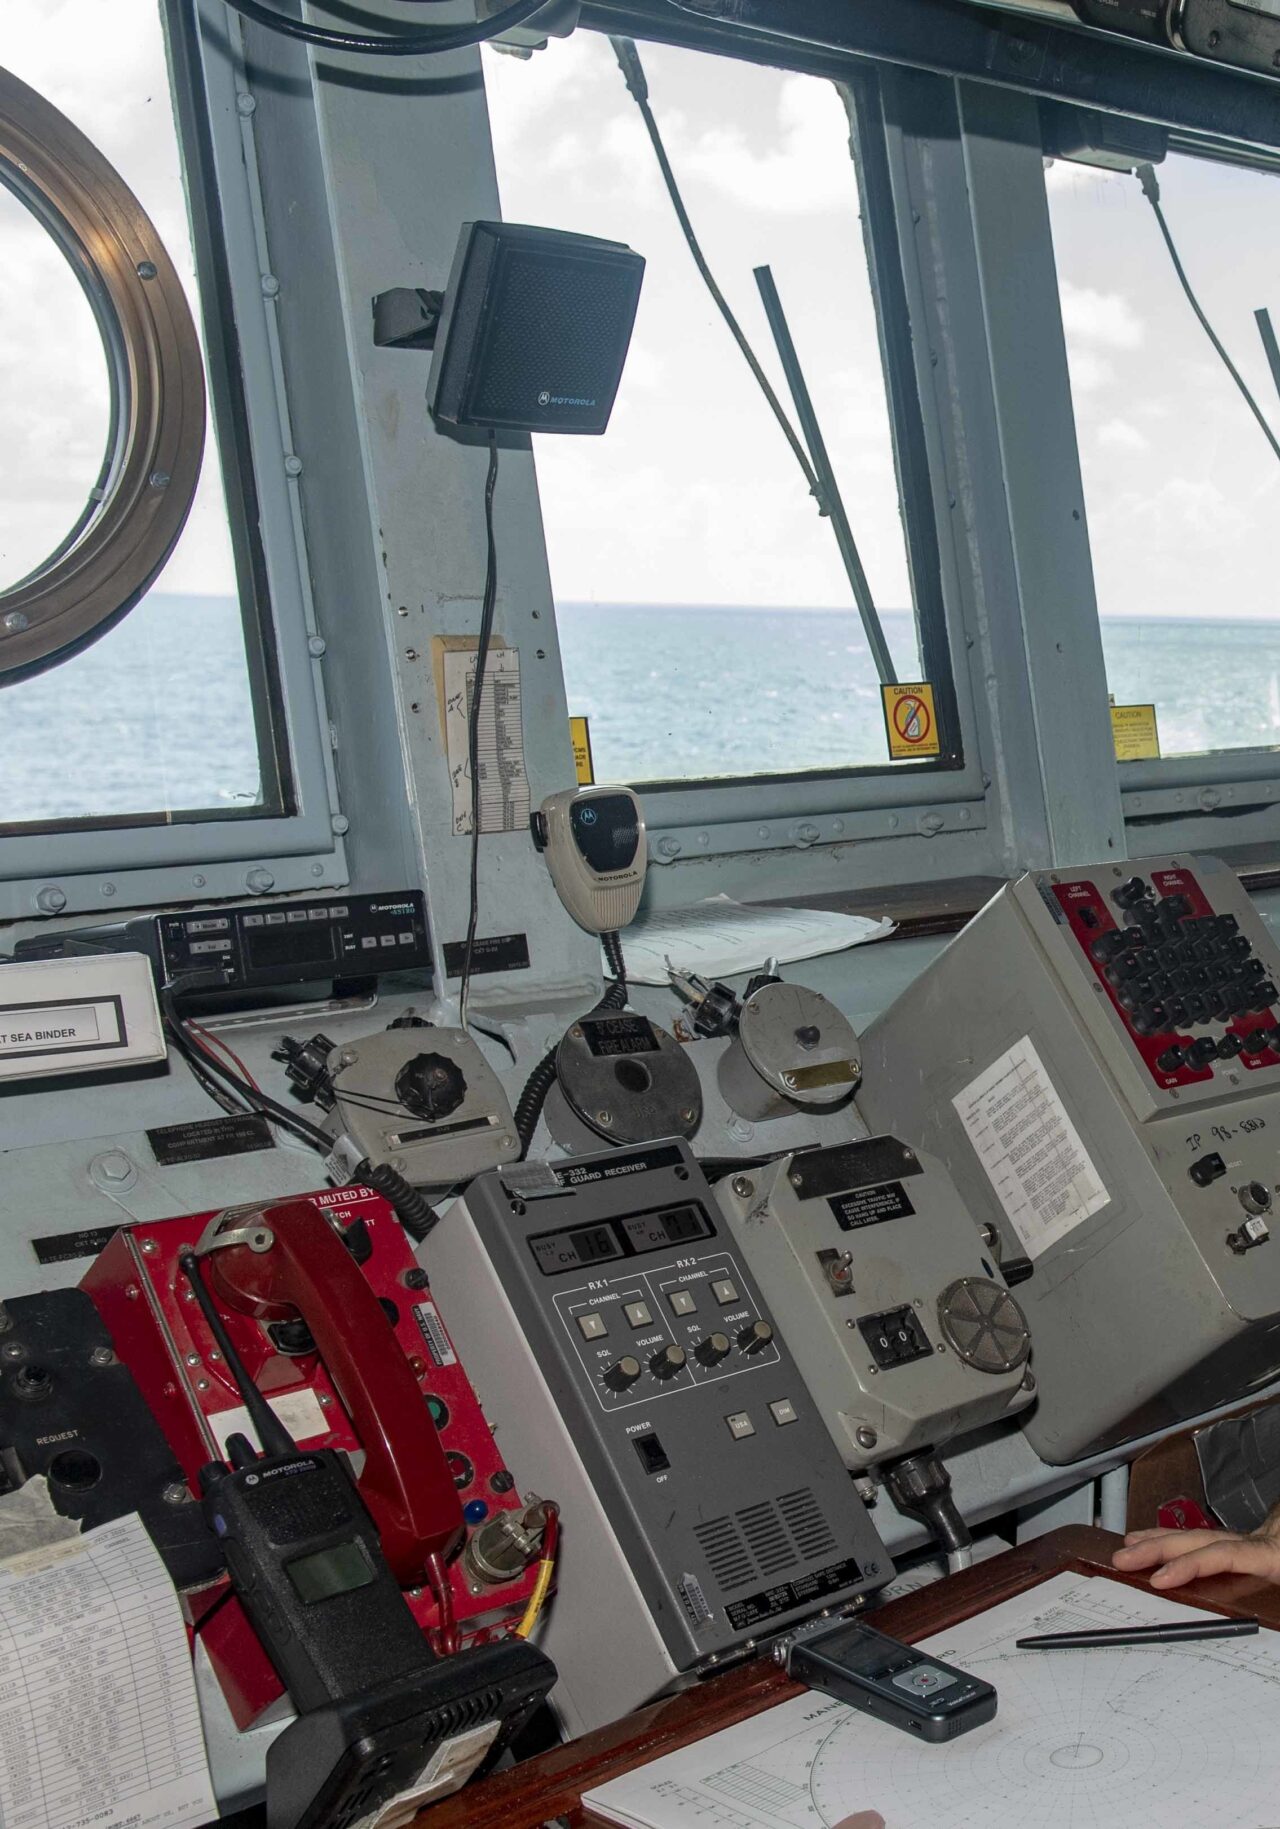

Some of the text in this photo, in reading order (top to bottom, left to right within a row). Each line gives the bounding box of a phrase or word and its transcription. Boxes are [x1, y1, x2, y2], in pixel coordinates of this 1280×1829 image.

[550, 396, 596, 406] MOTOROLA
[893, 686, 923, 696] CAUTION
[598, 870, 638, 882] MOTOROLA
[1162, 878, 1184, 887] CHANNEL
[1067, 890, 1091, 899] CHANNEL
[378, 902, 414, 911] MOTOROLA
[10, 1033, 32, 1042] SEA
[35, 1028, 76, 1040] BINDER
[1165, 1077, 1178, 1085] GAIN
[555, 1166, 588, 1180] E-332
[570, 1171, 602, 1184] GUARD
[604, 1161, 648, 1177] RECEIVER
[318, 1189, 358, 1206] MUTED
[359, 1187, 375, 1198] BY
[854, 1189, 877, 1199] CAUTION
[841, 1199, 867, 1210] EXCESSIVE
[649, 1230, 666, 1242] CH
[559, 1232, 613, 1263] CH 16
[676, 1257, 698, 1269] RX2
[678, 1270, 709, 1283] CHANNEL
[587, 1278, 609, 1291] RX1
[588, 1292, 621, 1306] CHANNEL
[723, 1310, 751, 1323] VOLUME
[687, 1324, 702, 1333] SQL
[636, 1334, 665, 1347] VOLUME
[880, 1331, 907, 1348] 0 0
[596, 1348, 613, 1358] SQL
[778, 1407, 790, 1416] DIM
[625, 1421, 652, 1435] POWER
[735, 1420, 748, 1430] USA
[36, 1429, 79, 1446] REQUEST
[262, 1460, 315, 1478] MOTOROLA
[656, 1474, 668, 1484] OFF
